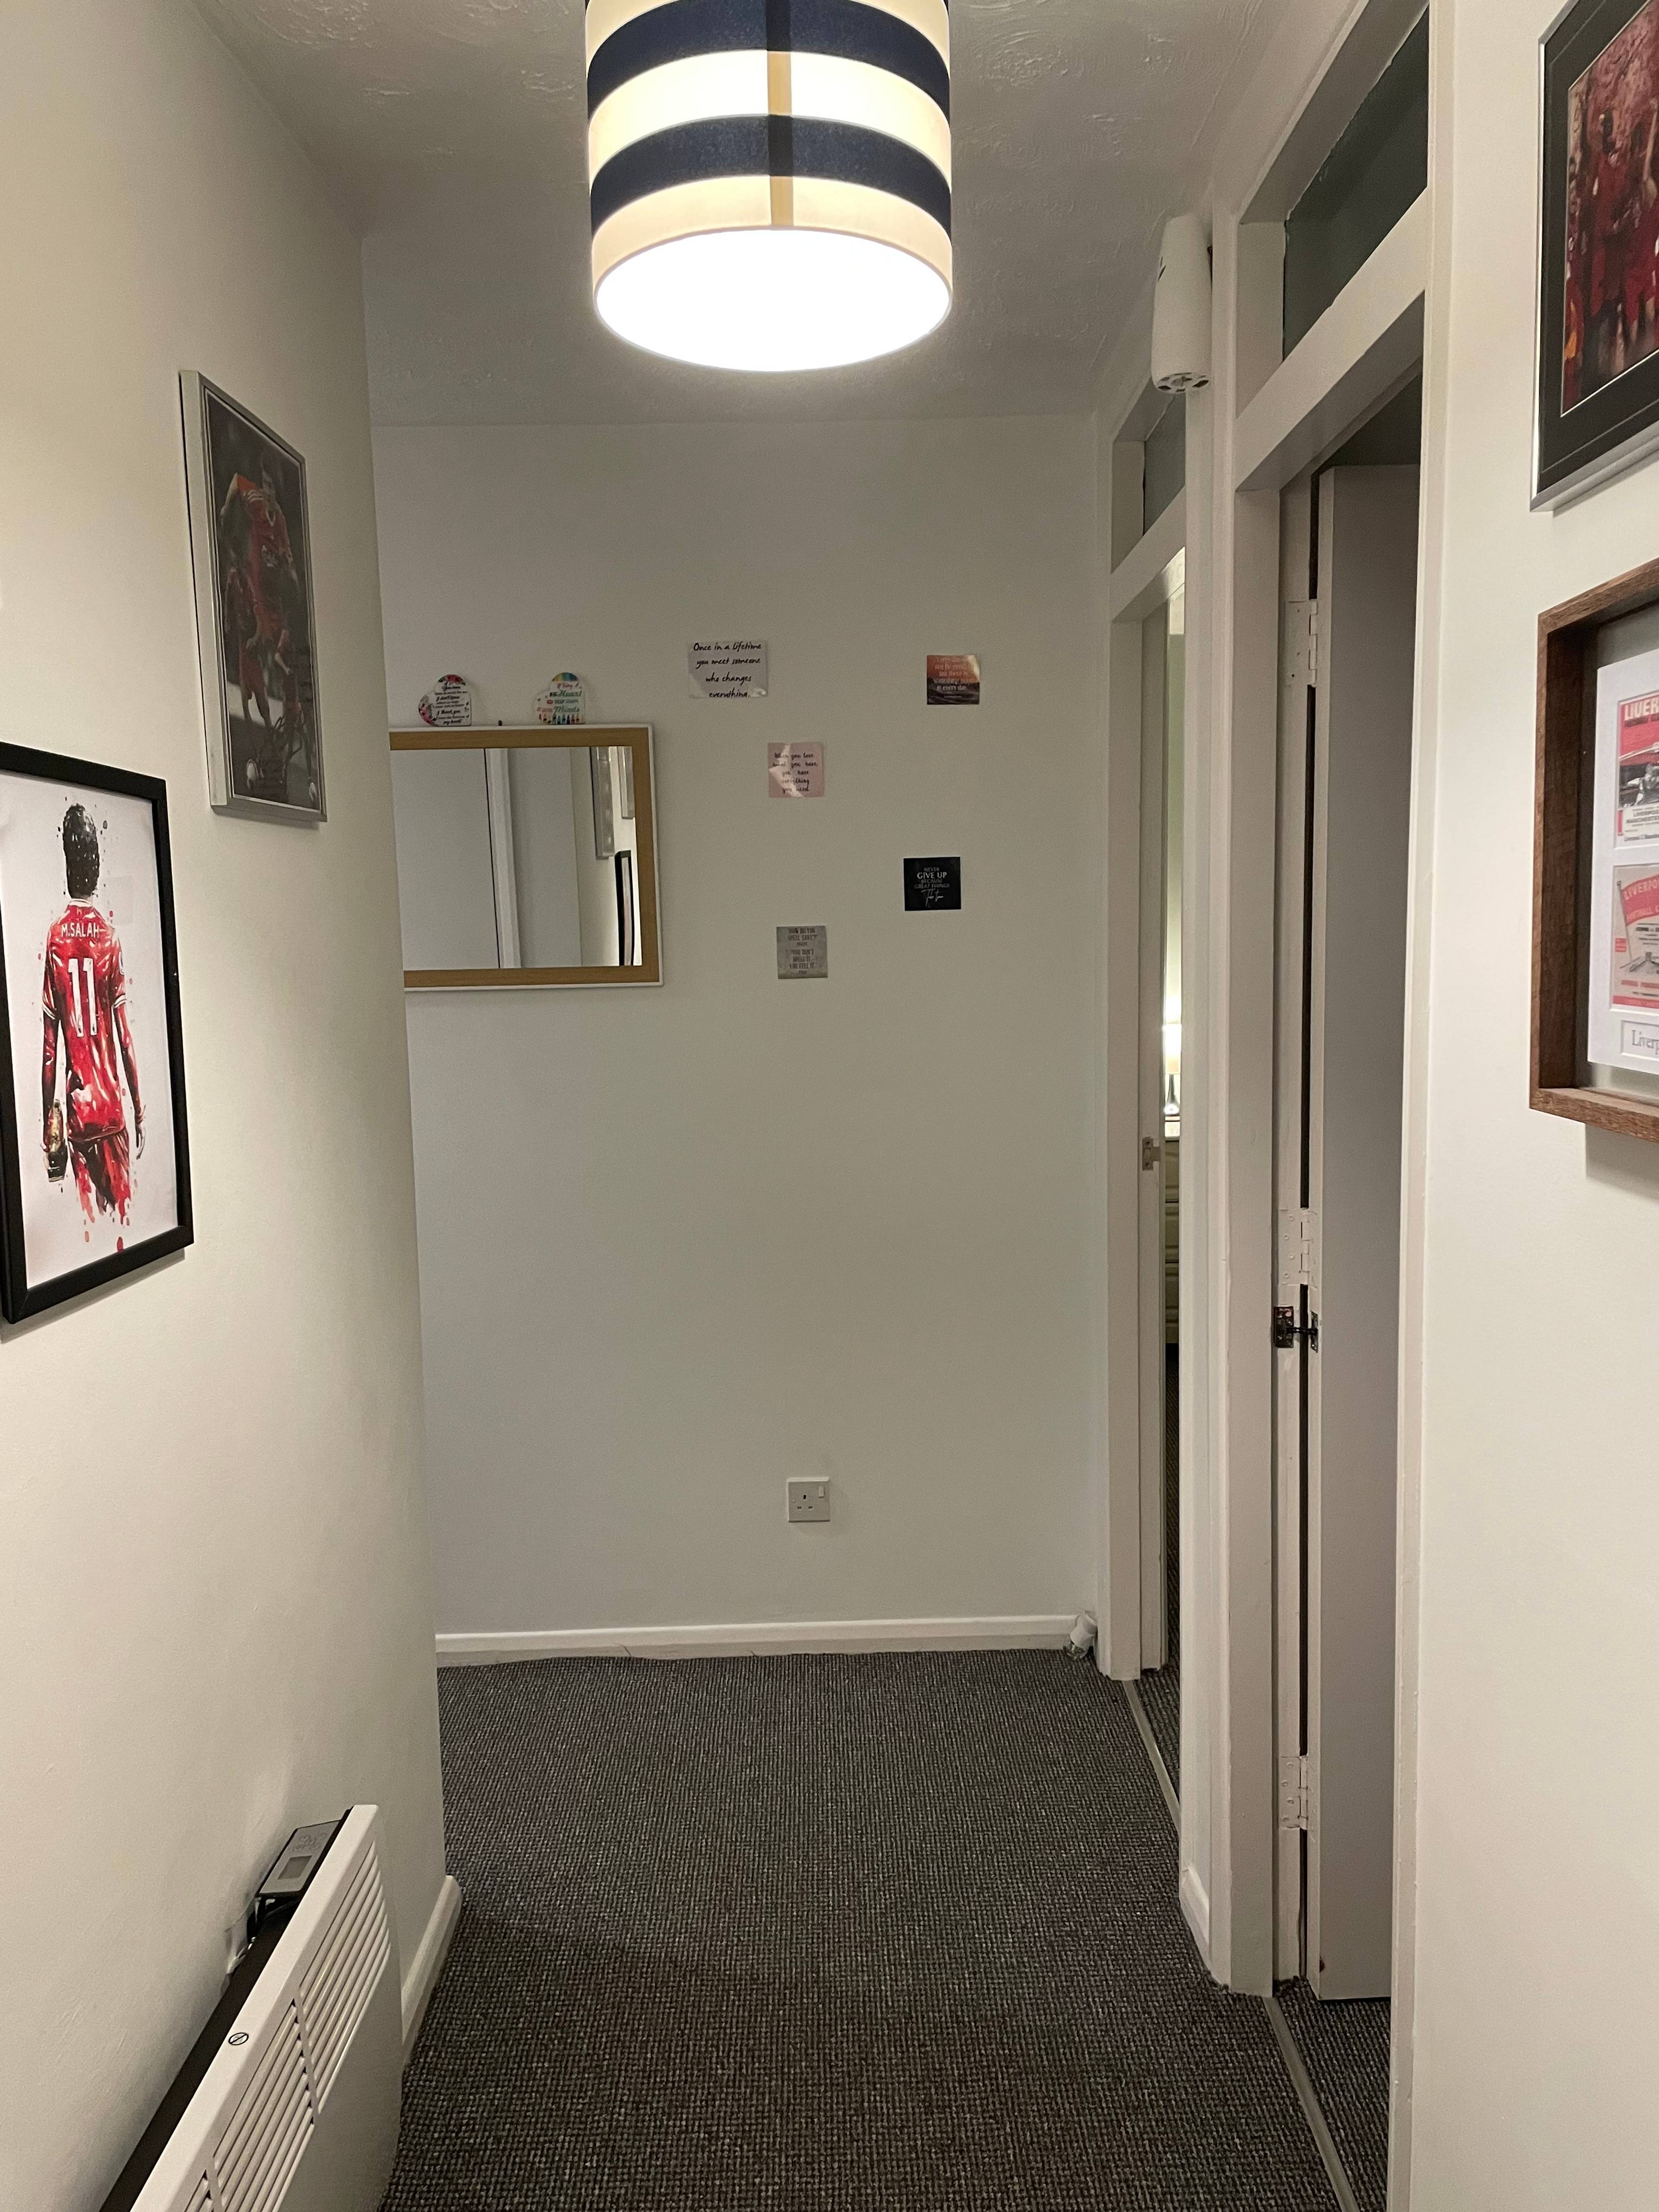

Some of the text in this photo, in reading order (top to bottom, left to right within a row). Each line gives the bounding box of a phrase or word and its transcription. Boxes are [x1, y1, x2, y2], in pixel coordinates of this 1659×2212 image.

[693, 642, 711, 651] Once
[733, 641, 762, 652] lifetime
[696, 660, 709, 669] you
[706, 671, 752, 686] who changes
[1624, 879, 1659, 900] LIVERPO
[61, 922, 99, 938] M.SALAH
[68, 957, 97, 1037] 11
